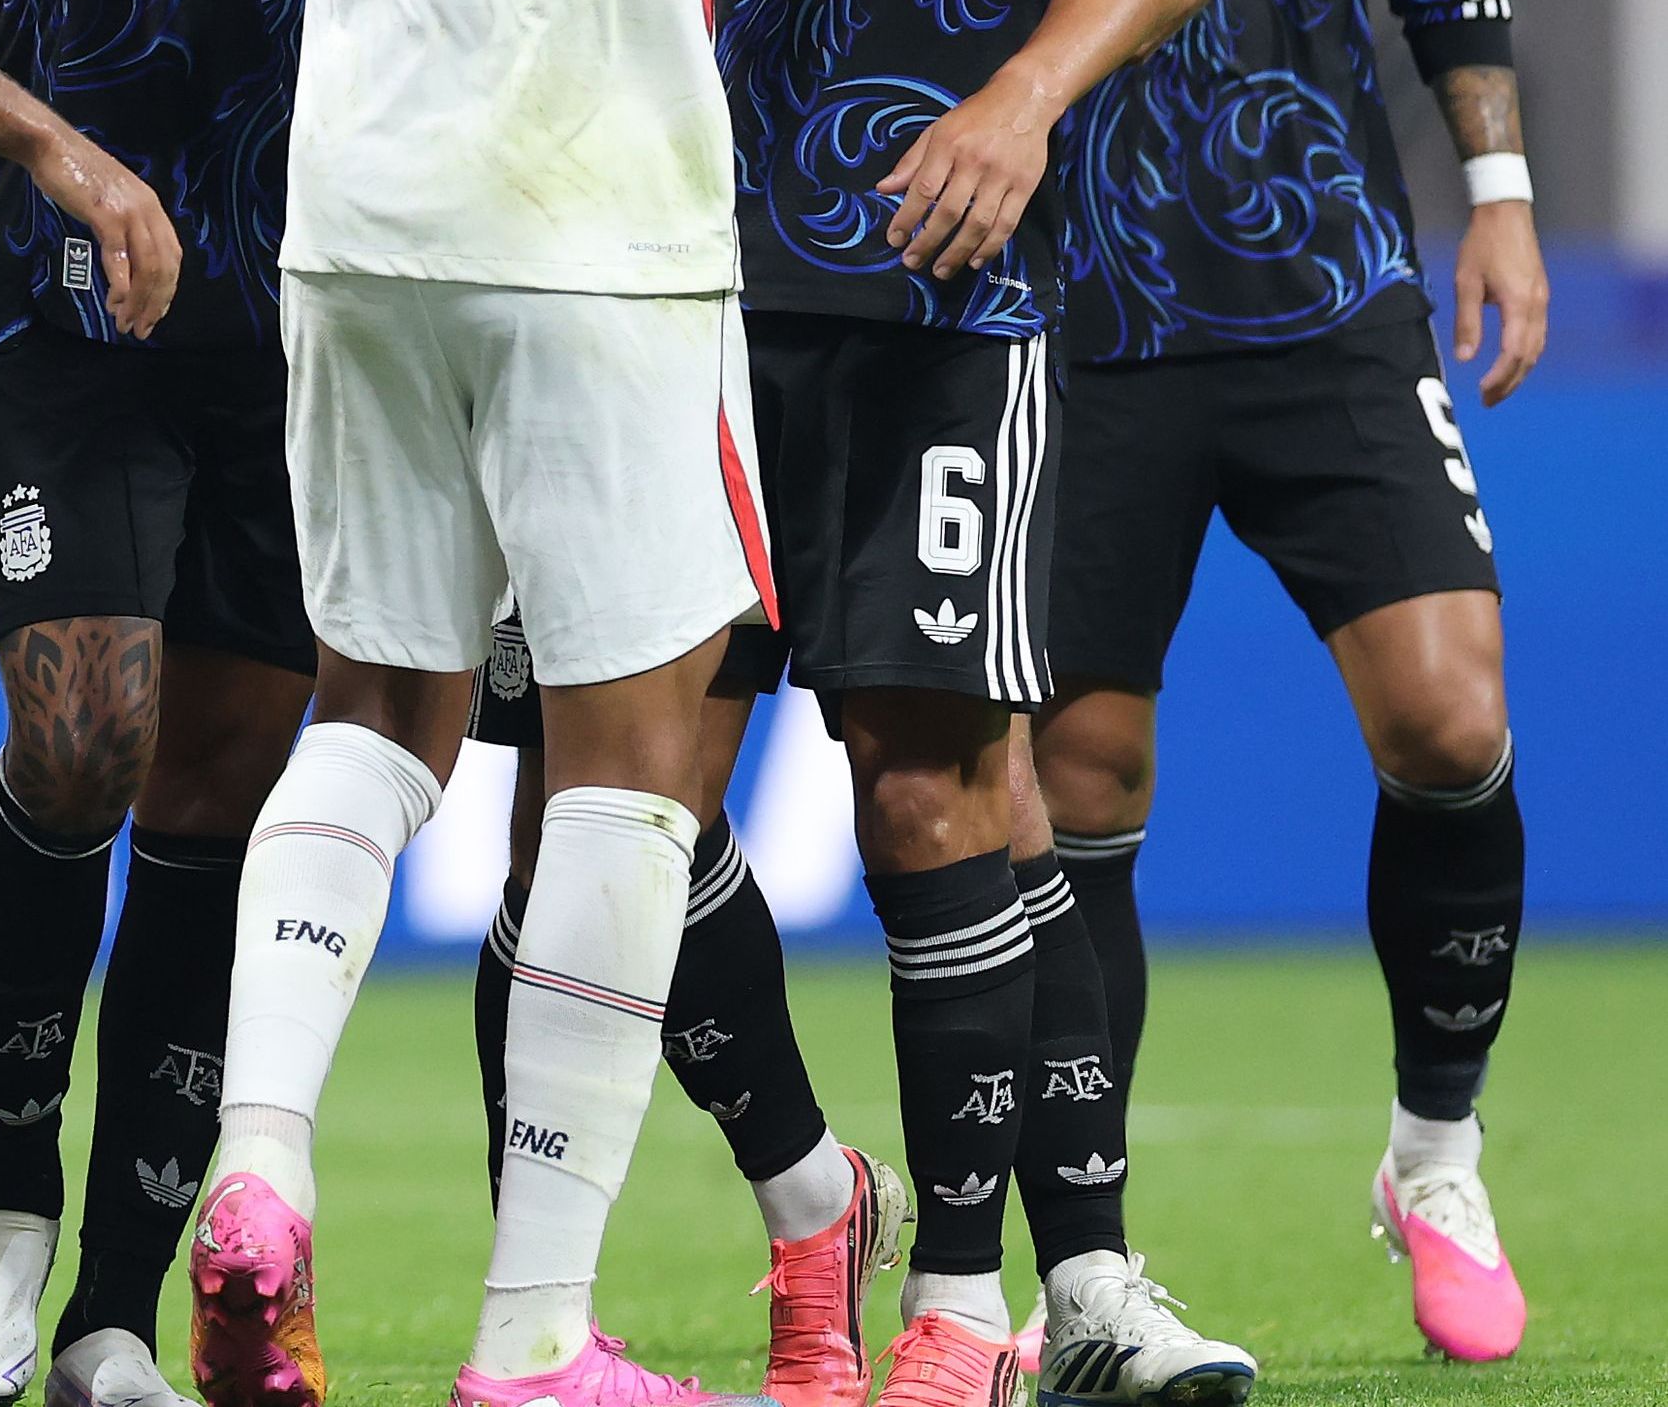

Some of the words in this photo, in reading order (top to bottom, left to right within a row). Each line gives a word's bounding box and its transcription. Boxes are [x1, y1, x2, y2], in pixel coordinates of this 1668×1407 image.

[917, 445, 986, 576] 6
[274, 918, 347, 958] ENG
[951, 1068, 1016, 1125] AFA
[1041, 1054, 1114, 1103] AFA
[509, 1118, 569, 1161] ENG
